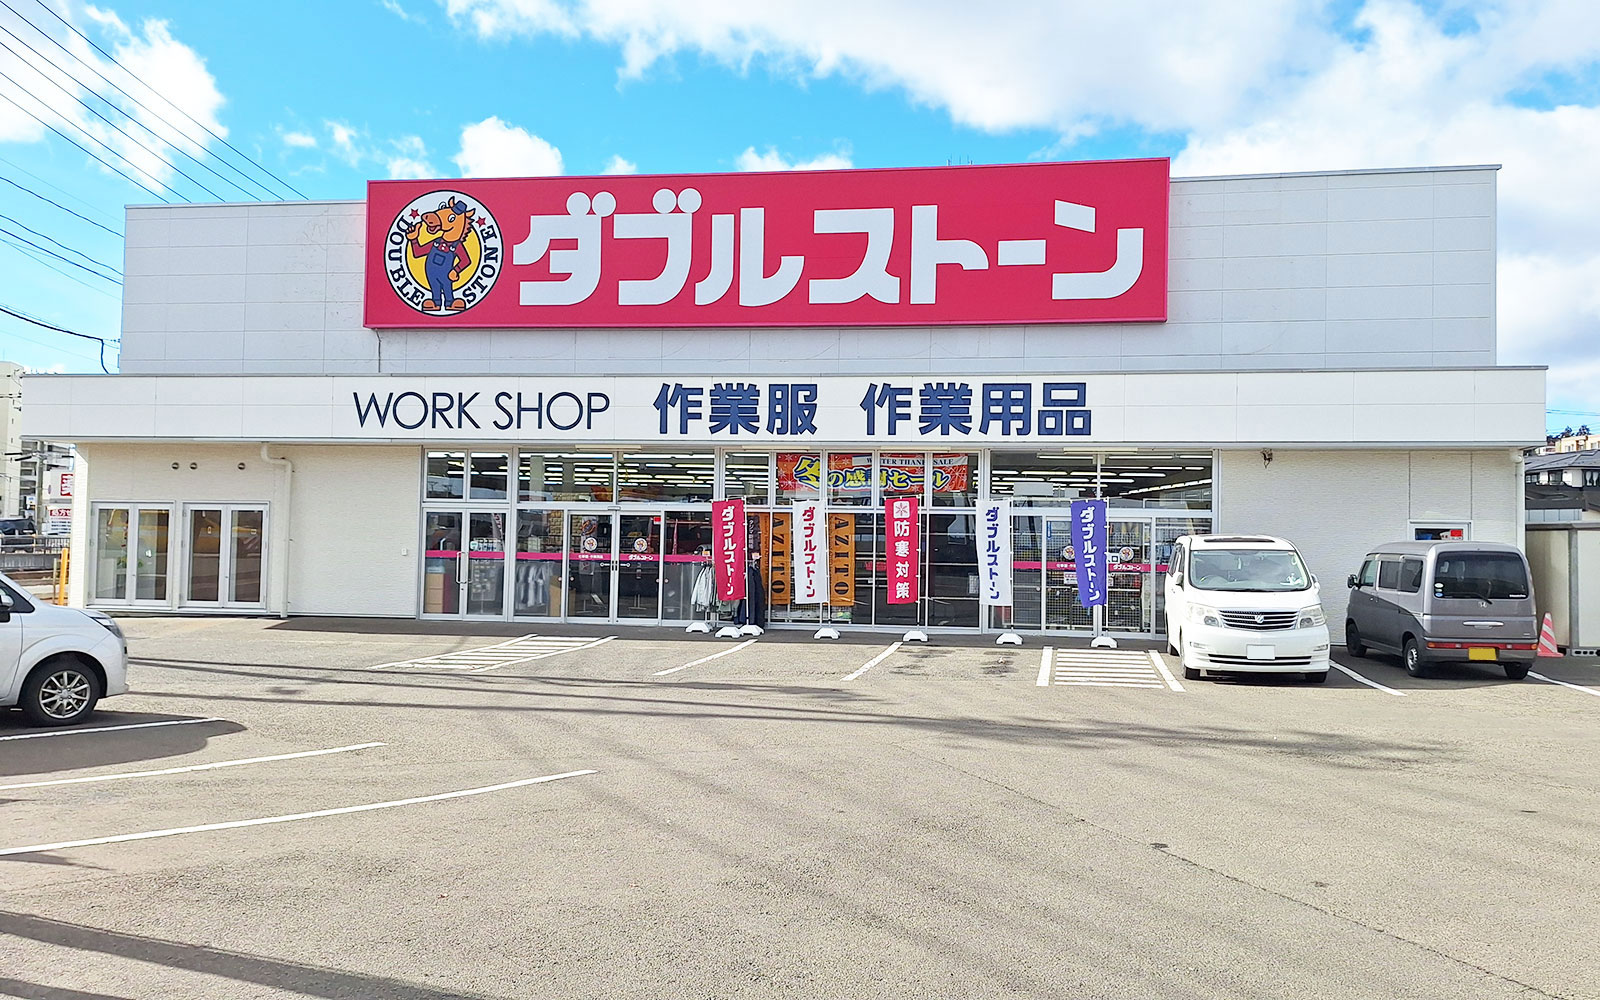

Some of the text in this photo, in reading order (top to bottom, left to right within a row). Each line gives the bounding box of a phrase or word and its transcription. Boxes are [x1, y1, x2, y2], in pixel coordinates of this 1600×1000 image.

[388, 215, 425, 306] DOUBLE
[462, 225, 498, 304] STONE
[513, 188, 1144, 306] ダブルストーン
[353, 391, 610, 430] WORK SHOP
[653, 382, 1092, 436] 作業服 作業用品
[721, 505, 737, 596] ダブルストーン
[771, 517, 785, 594] AZITO
[802, 506, 817, 598] ダブルストーン
[834, 516, 849, 595] AZITO
[893, 520, 910, 599] 防寒対策
[985, 506, 1000, 600] ダブルストーン
[1080, 506, 1100, 601] ダブルストーン
